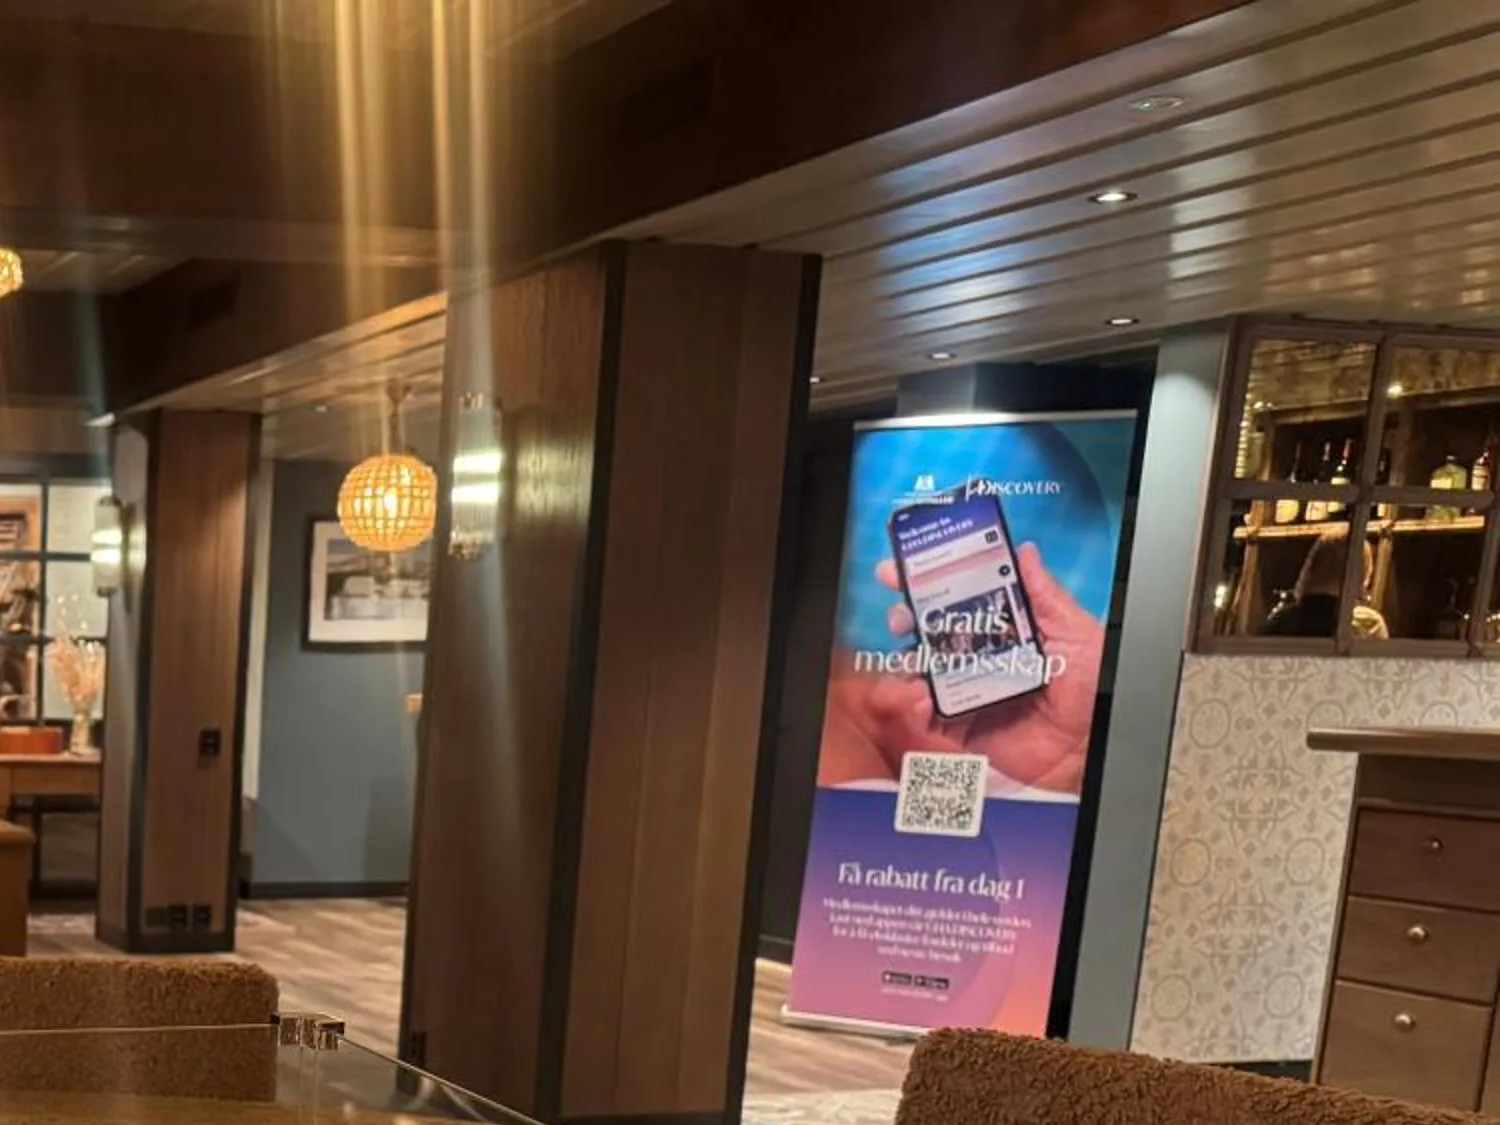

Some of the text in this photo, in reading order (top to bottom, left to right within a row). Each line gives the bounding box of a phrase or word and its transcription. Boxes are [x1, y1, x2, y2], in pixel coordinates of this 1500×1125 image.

[922, 606, 1010, 635] Gratis
[854, 643, 1067, 684] medlemsskap
[838, 862, 862, 885] Få
[865, 865, 930, 891] rabatt
[933, 868, 965, 894] fra
[968, 873, 1013, 903] dag
